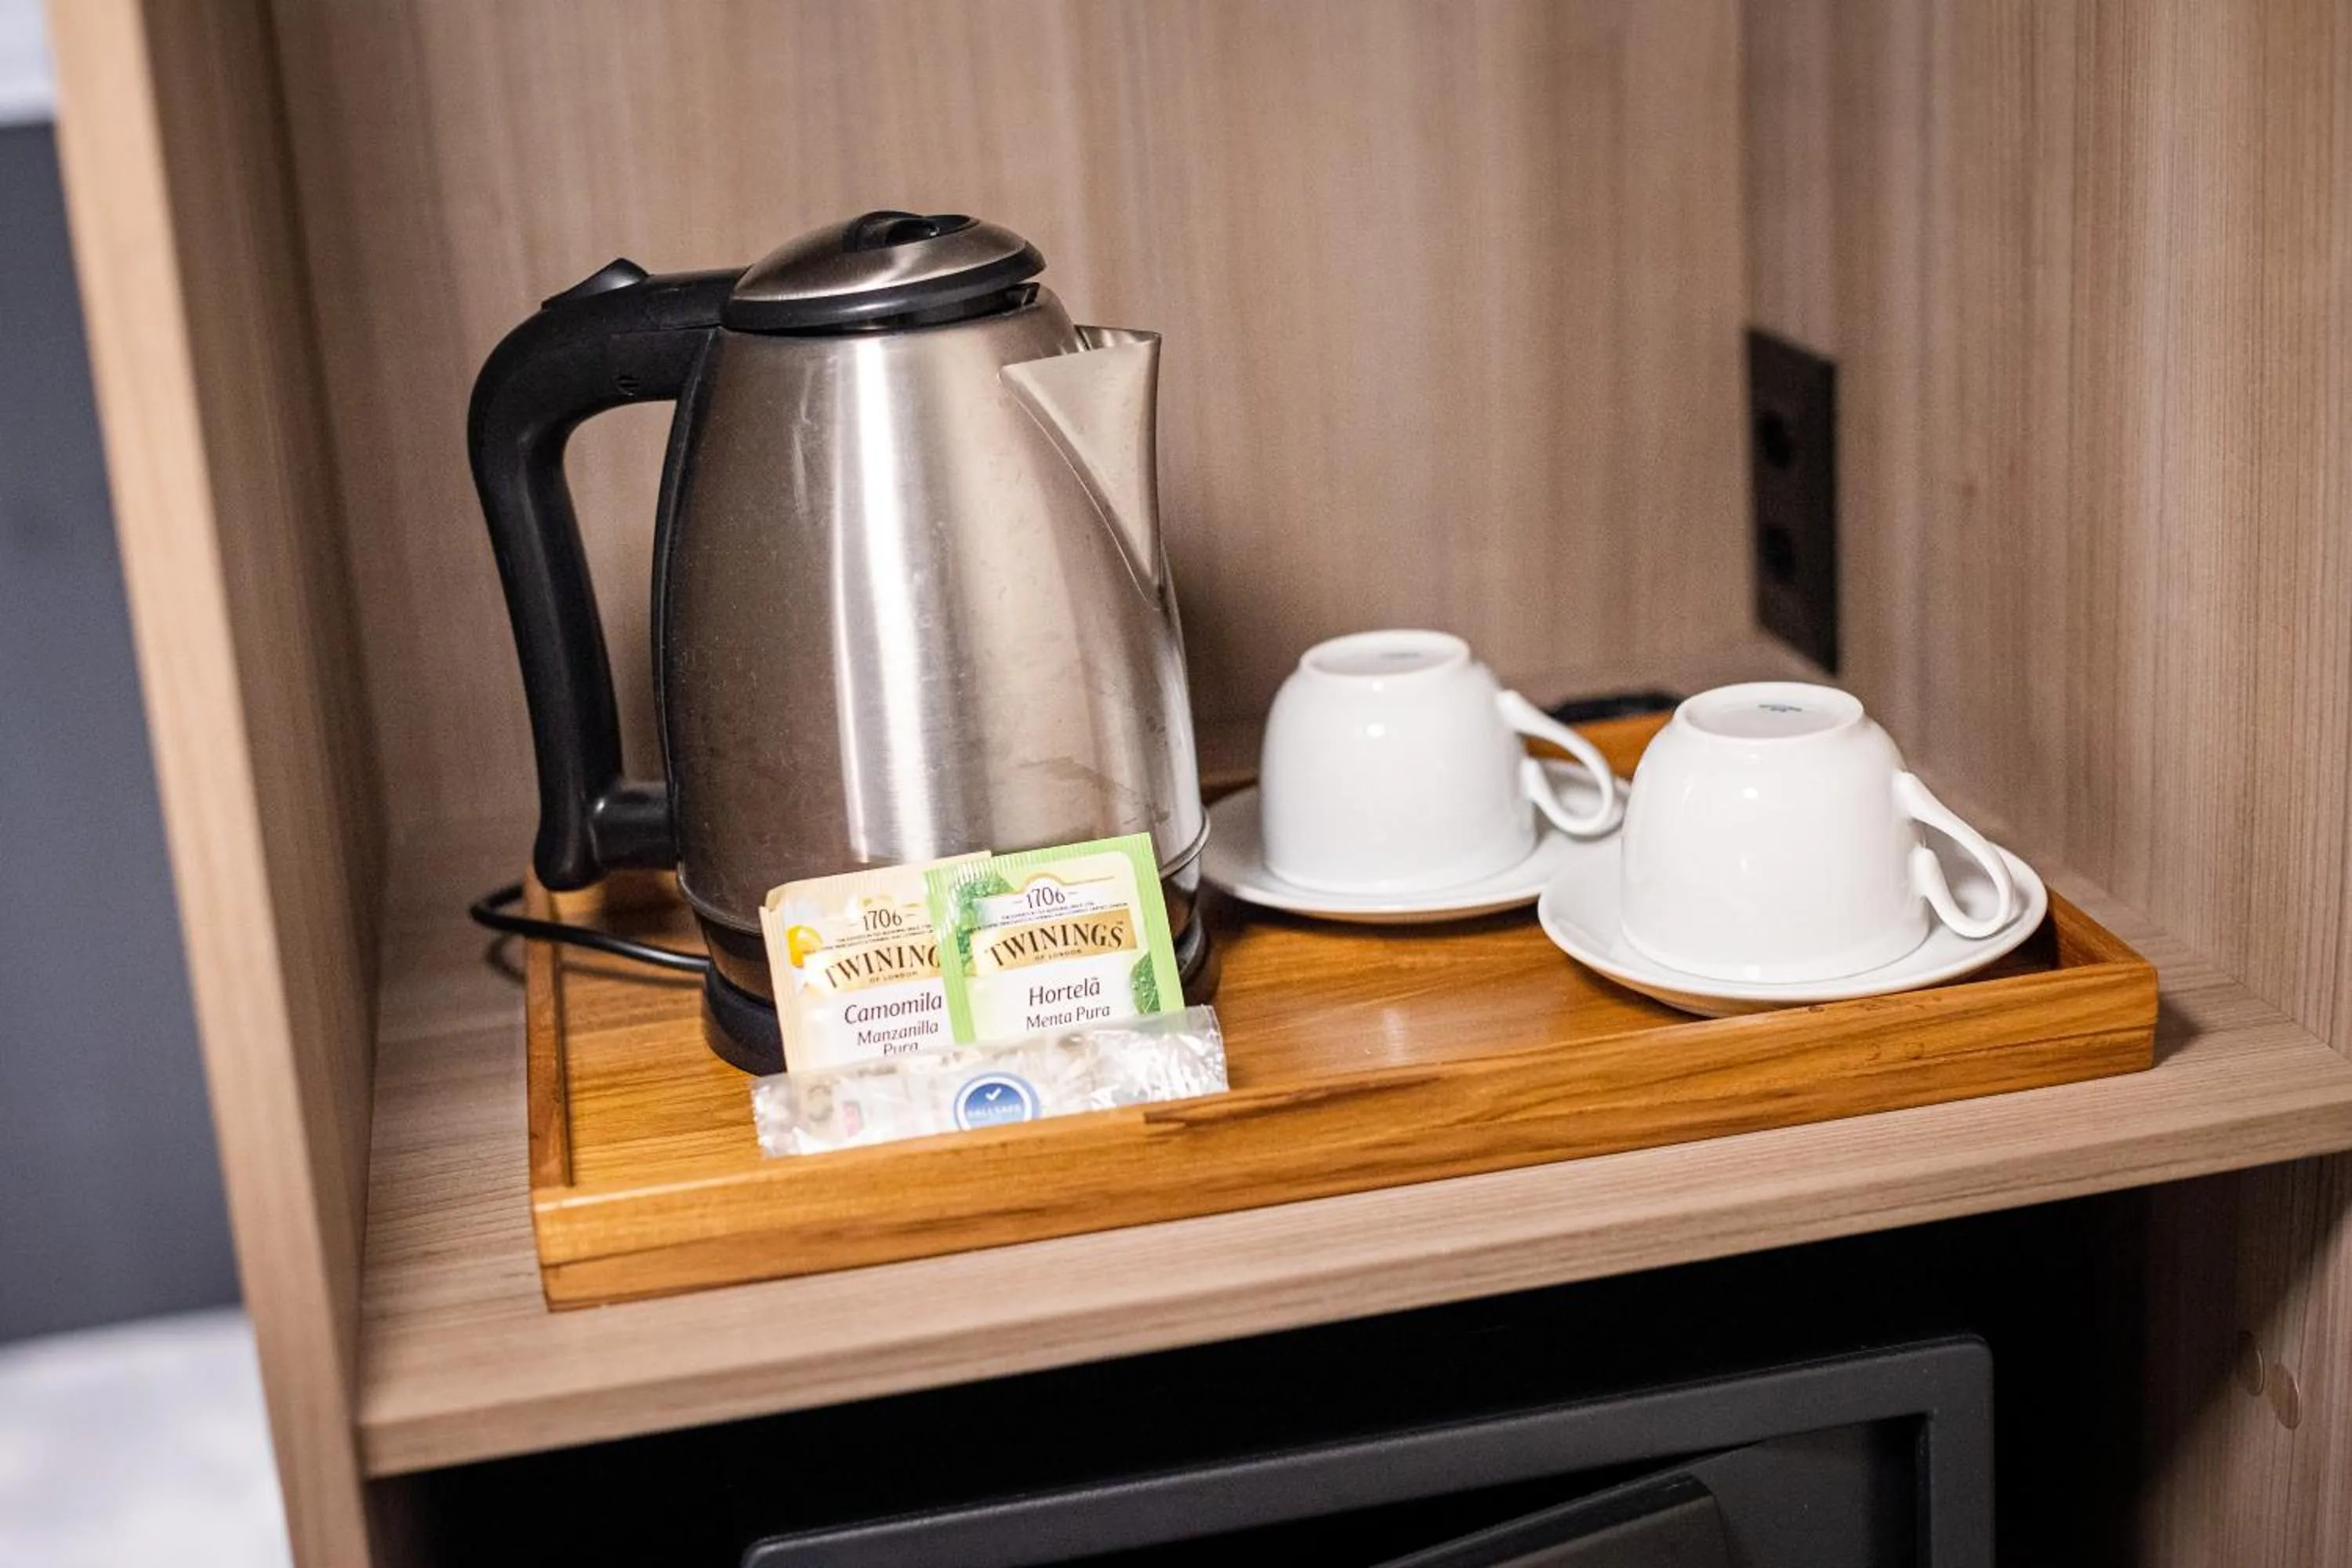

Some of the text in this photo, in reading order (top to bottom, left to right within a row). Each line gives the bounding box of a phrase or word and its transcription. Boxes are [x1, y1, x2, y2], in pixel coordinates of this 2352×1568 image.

[1026, 887, 1065, 909] 1706
[863, 909, 902, 931] 1706
[985, 923, 1124, 967] TWININGS
[824, 944, 941, 989] TWINING
[1029, 977, 1101, 1006] Hortelã
[844, 992, 942, 1025] Camomila
[1025, 1005, 1110, 1031] Menta Pura
[857, 1020, 939, 1046] Manzanilla
[884, 1042, 918, 1056] Pura
